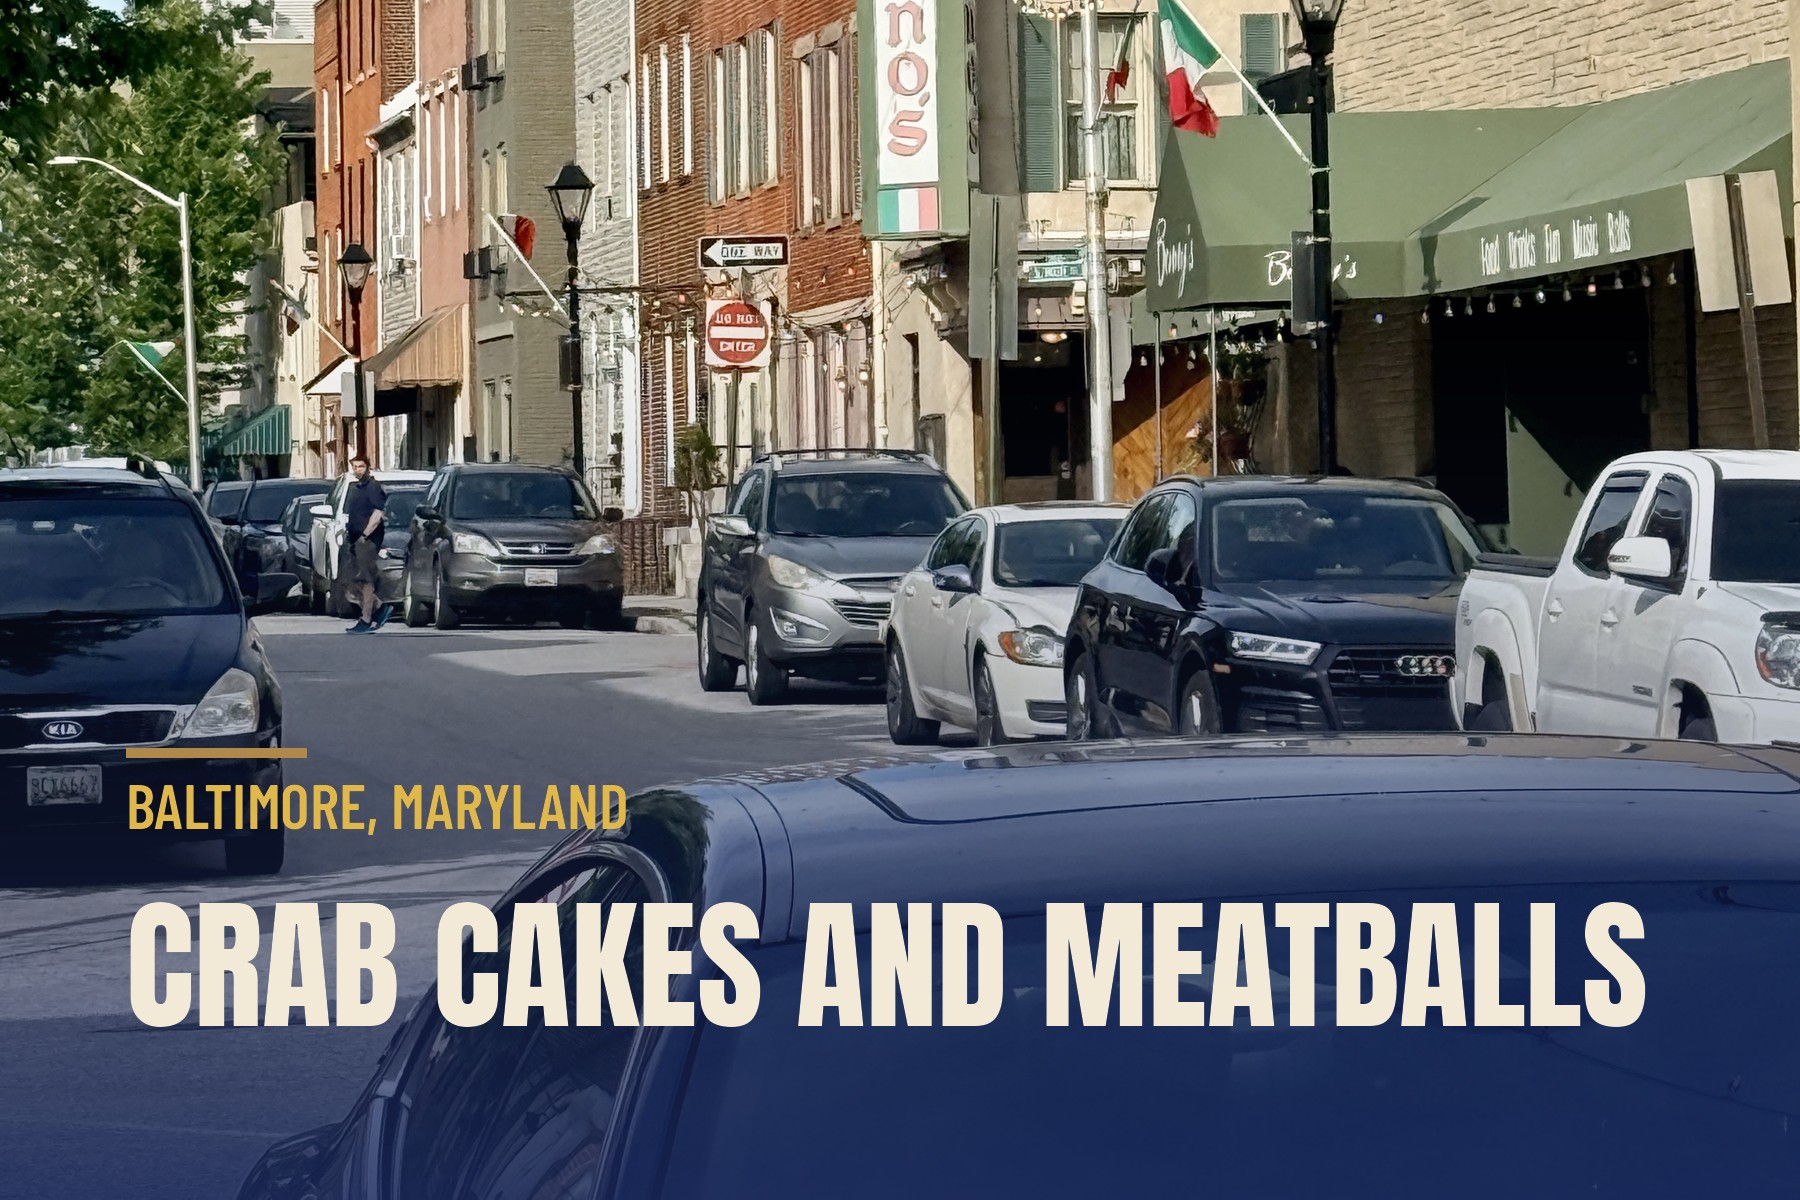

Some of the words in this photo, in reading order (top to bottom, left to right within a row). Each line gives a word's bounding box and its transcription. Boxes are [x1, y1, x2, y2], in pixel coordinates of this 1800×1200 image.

[1480, 234, 1501, 276] Food
[1507, 227, 1536, 269] Drinks
[1544, 223, 1561, 264] Fun
[1572, 216, 1599, 260] Music
[48, 724, 77, 735] KIA
